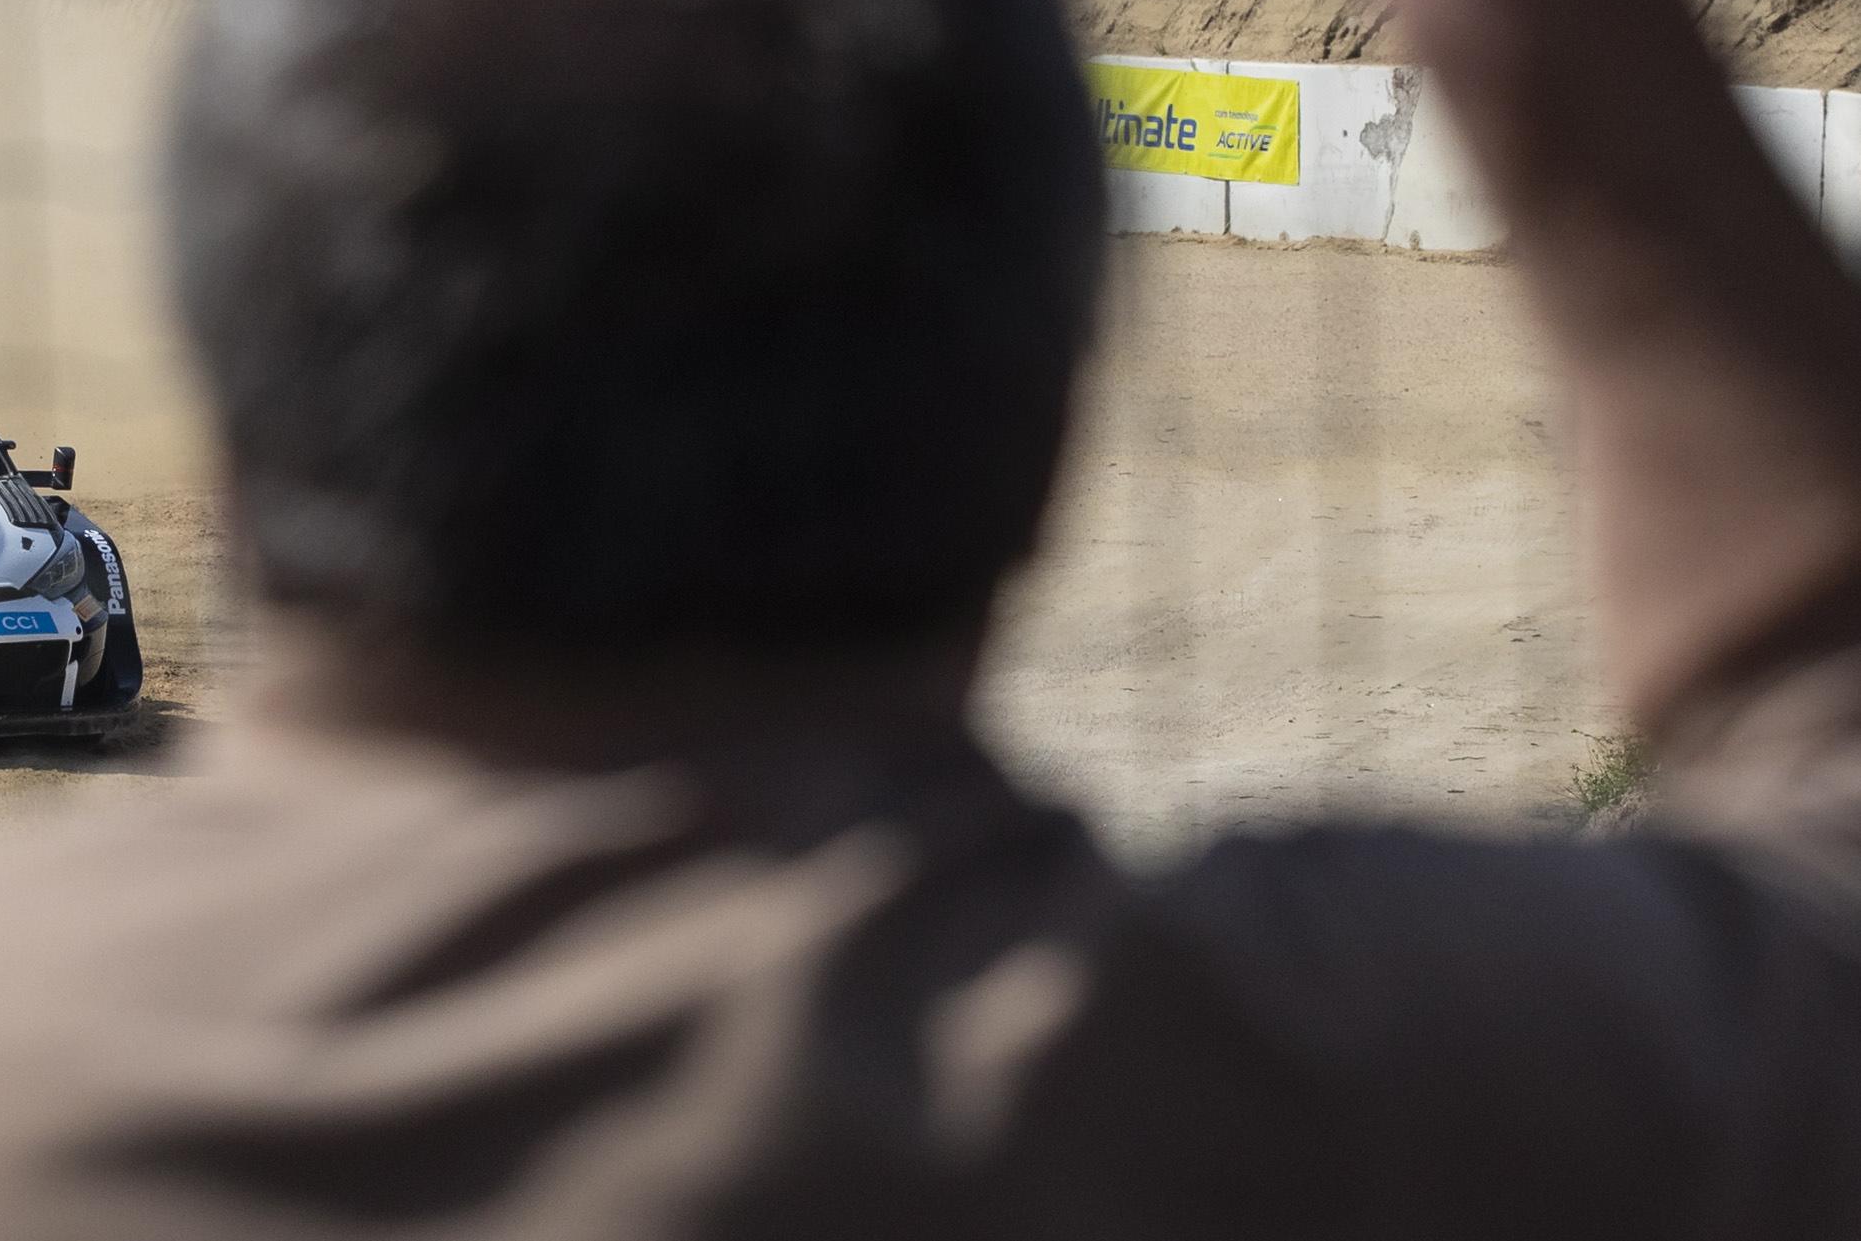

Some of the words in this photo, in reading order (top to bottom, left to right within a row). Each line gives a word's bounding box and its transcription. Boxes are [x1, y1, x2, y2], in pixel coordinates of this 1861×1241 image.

[1098, 98, 1198, 151] ltimate
[1216, 131, 1273, 152] ACTIVE
[84, 528, 126, 615] Panasonic
